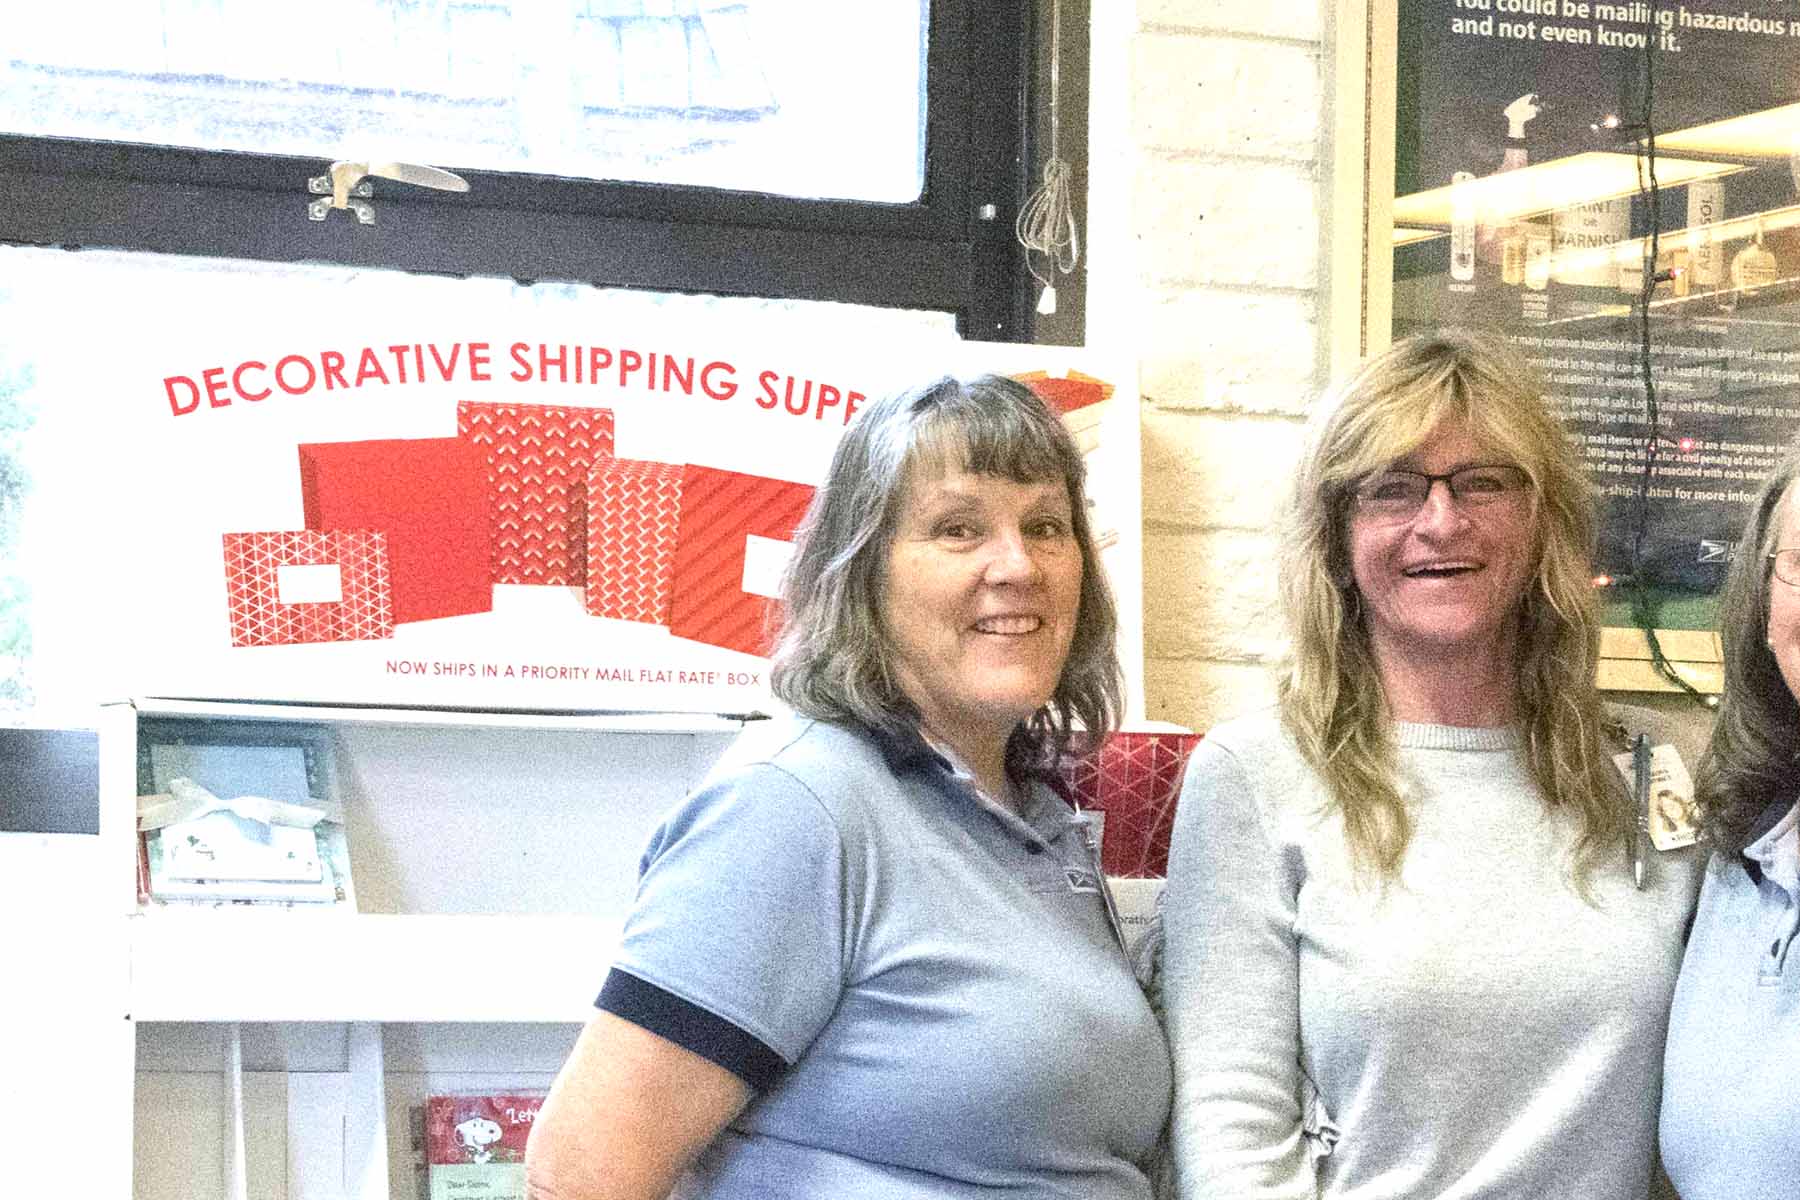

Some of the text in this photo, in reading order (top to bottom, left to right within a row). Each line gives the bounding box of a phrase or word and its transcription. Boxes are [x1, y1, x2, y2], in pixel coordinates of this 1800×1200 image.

[1452, 16, 1493, 37] and
[1499, 20, 1536, 40] not
[1541, 28, 1592, 45] even
[1660, 31, 1681, 52] it.
[1497, 0, 1557, 16] could
[1563, 0, 1589, 19] be
[1680, 8, 1786, 36] hazardous
[164, 343, 492, 418] DECORATIVE
[510, 342, 738, 402] SHIPPING
[1675, 485, 1726, 501] for more
[386, 660, 428, 675] NOW
[434, 663, 476, 677] SHIPS
[482, 664, 498, 678] IN
[504, 665, 516, 678] A
[521, 665, 590, 681] PRIORITY
[596, 668, 634, 682] MAIL
[640, 669, 673, 683] FLAT
[728, 673, 761, 686] BOX
